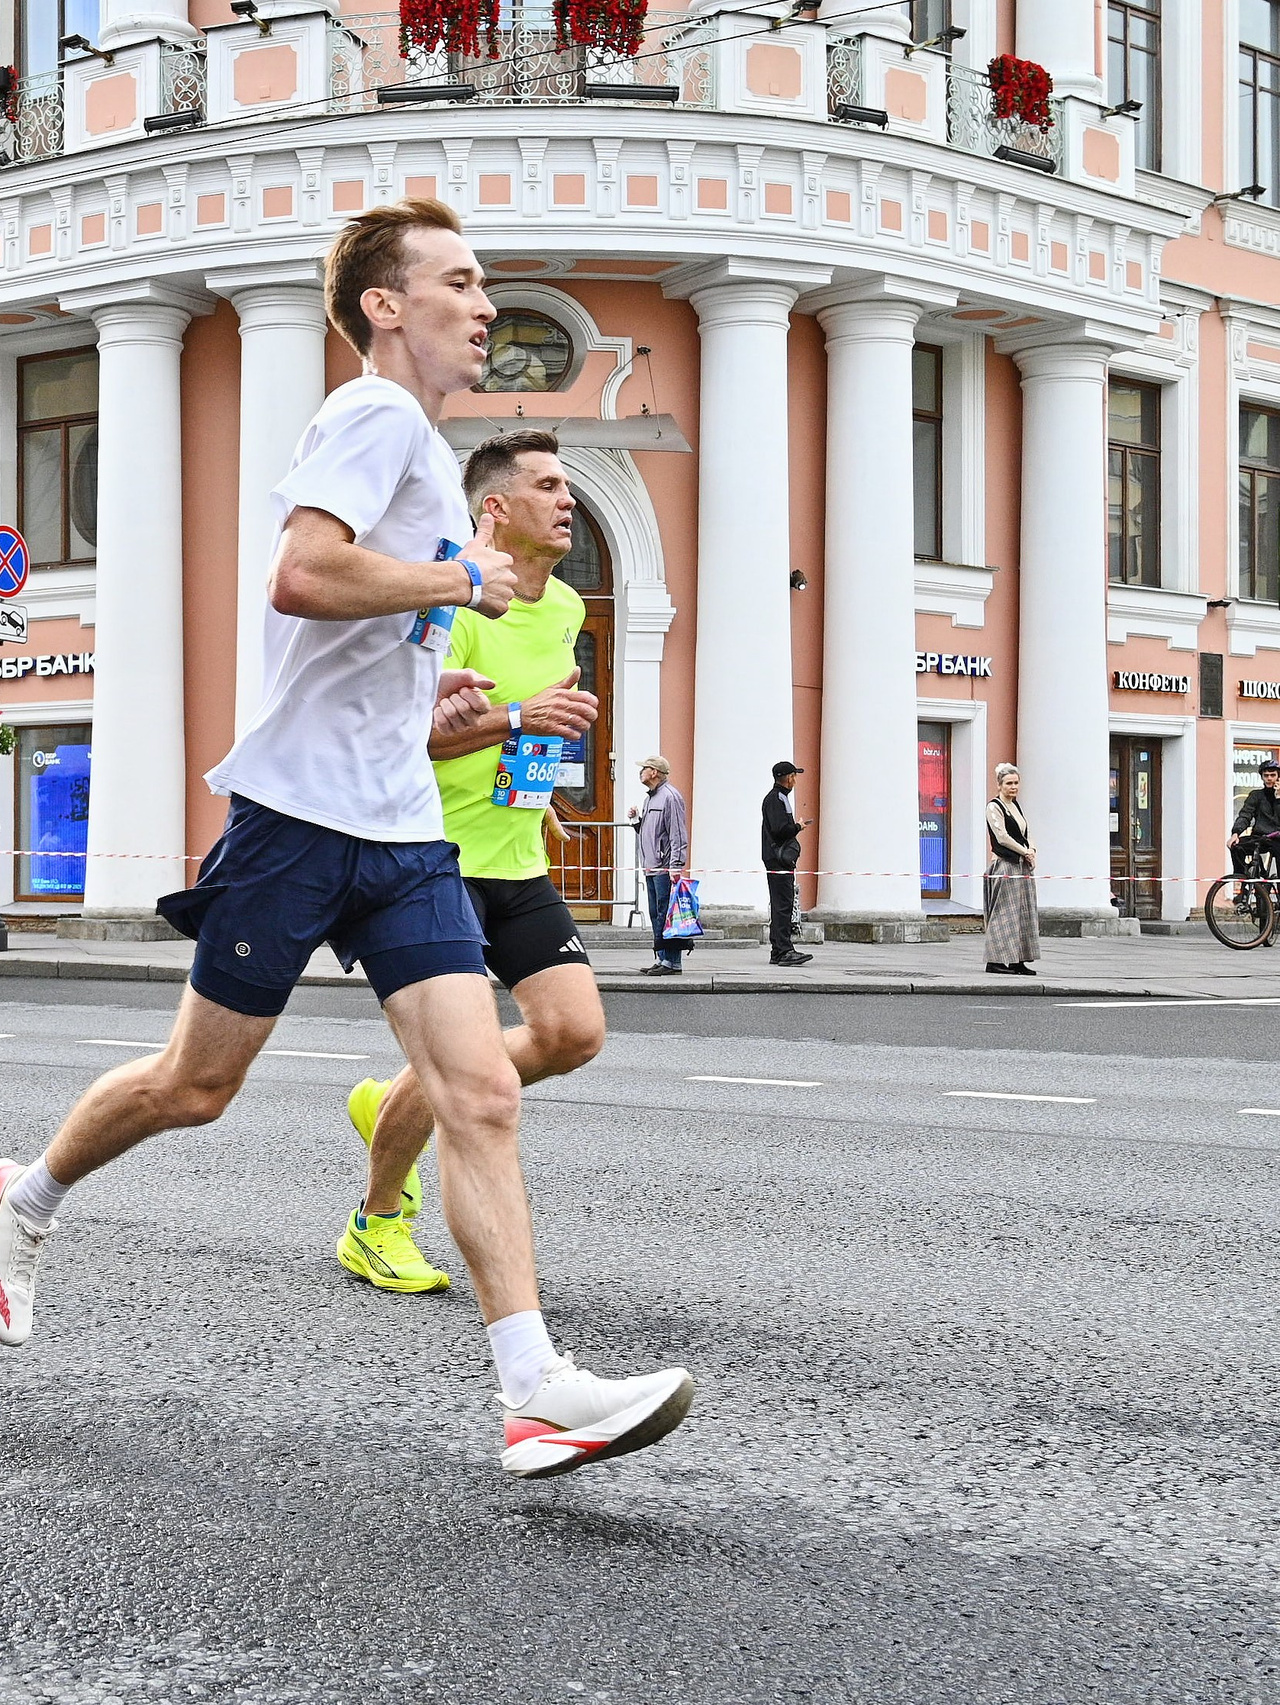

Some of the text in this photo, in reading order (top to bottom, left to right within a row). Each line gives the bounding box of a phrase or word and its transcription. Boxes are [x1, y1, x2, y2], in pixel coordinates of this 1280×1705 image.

[36, 653, 94, 676] БАНК
[941, 654, 992, 676] БАНК
[1118, 671, 1191, 693] КОНФЕТЫ
[1233, 749, 1272, 765] НФЕТЫ
[498, 775, 508, 786] B
